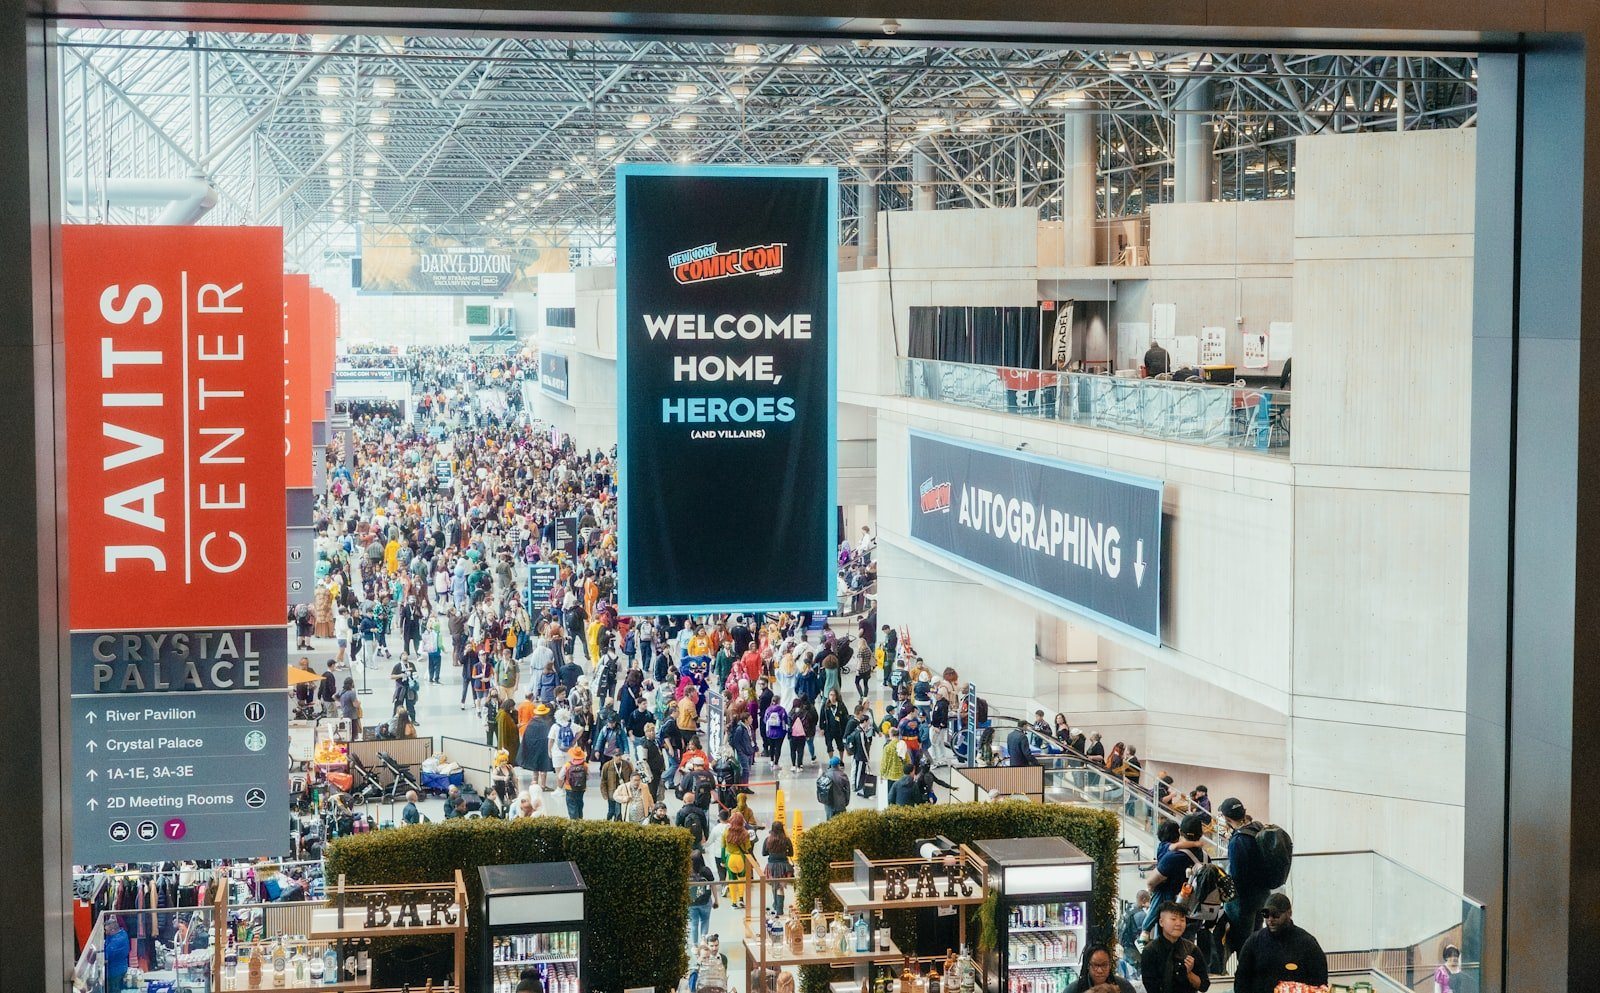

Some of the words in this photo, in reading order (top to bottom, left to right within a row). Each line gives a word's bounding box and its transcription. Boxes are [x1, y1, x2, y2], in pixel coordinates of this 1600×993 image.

[420, 254, 467, 273] DARYL
[468, 254, 512, 274] DIXON
[670, 252, 690, 266] NEW
[692, 244, 716, 260] YORK
[676, 252, 739, 282] COMIC
[741, 245, 781, 271] CON
[643, 313, 812, 340] WELCOME
[673, 355, 783, 385] HOME,
[662, 397, 796, 423] HEROES
[99, 283, 167, 573] JAVITS
[197, 281, 247, 574] CENTER
[690, 429, 717, 440] (AND
[718, 429, 766, 439] VILLAINS)
[958, 482, 1121, 579] AUTOGRAPHING
[92, 632, 260, 663] CRYSTAL
[93, 660, 260, 691] PALACE
[106, 709, 141, 722] River
[144, 708, 196, 720] Pavilion
[106, 738, 154, 752] Crystal
[158, 737, 203, 749] Palace
[107, 767, 149, 780] 1A-1E,
[153, 765, 194, 778] 3A-3E
[107, 796, 126, 809] 2D
[130, 795, 183, 809] Meeting
[187, 793, 234, 806] Rooms
[170, 823, 180, 837] 7
[883, 864, 973, 901] BAR
[363, 890, 457, 928] BAR
